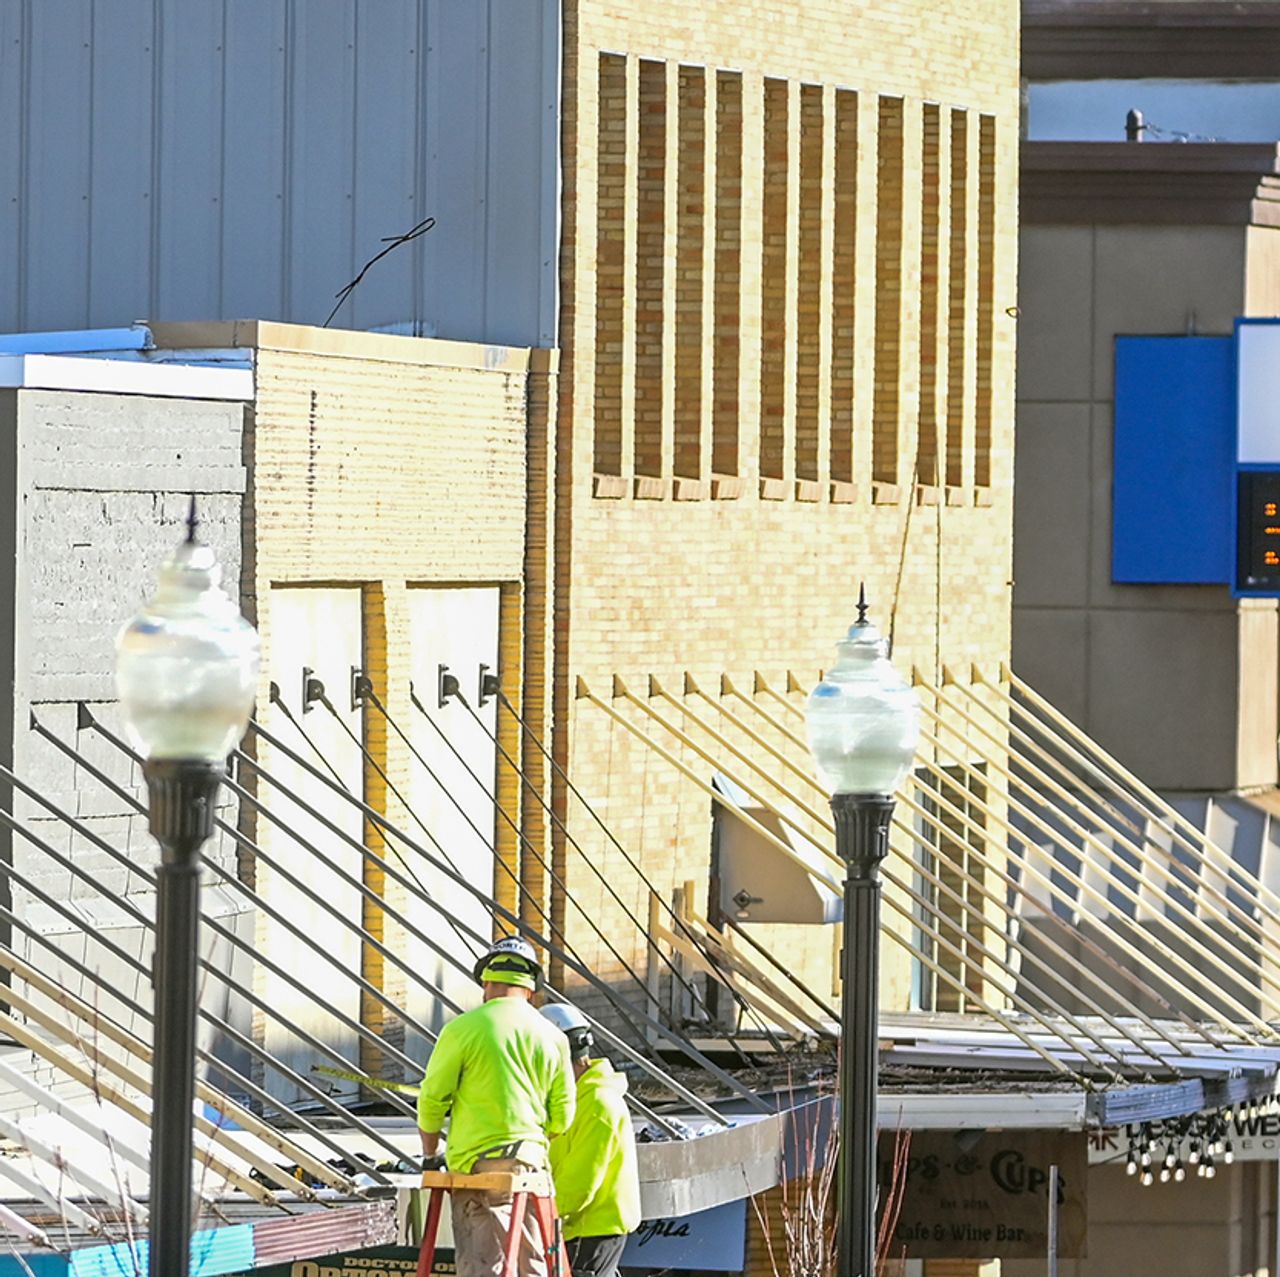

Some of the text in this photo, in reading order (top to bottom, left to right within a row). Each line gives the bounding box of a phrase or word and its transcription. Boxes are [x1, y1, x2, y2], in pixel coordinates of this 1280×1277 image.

[896, 1222, 1025, 1242] Cafe & Wine Bar
